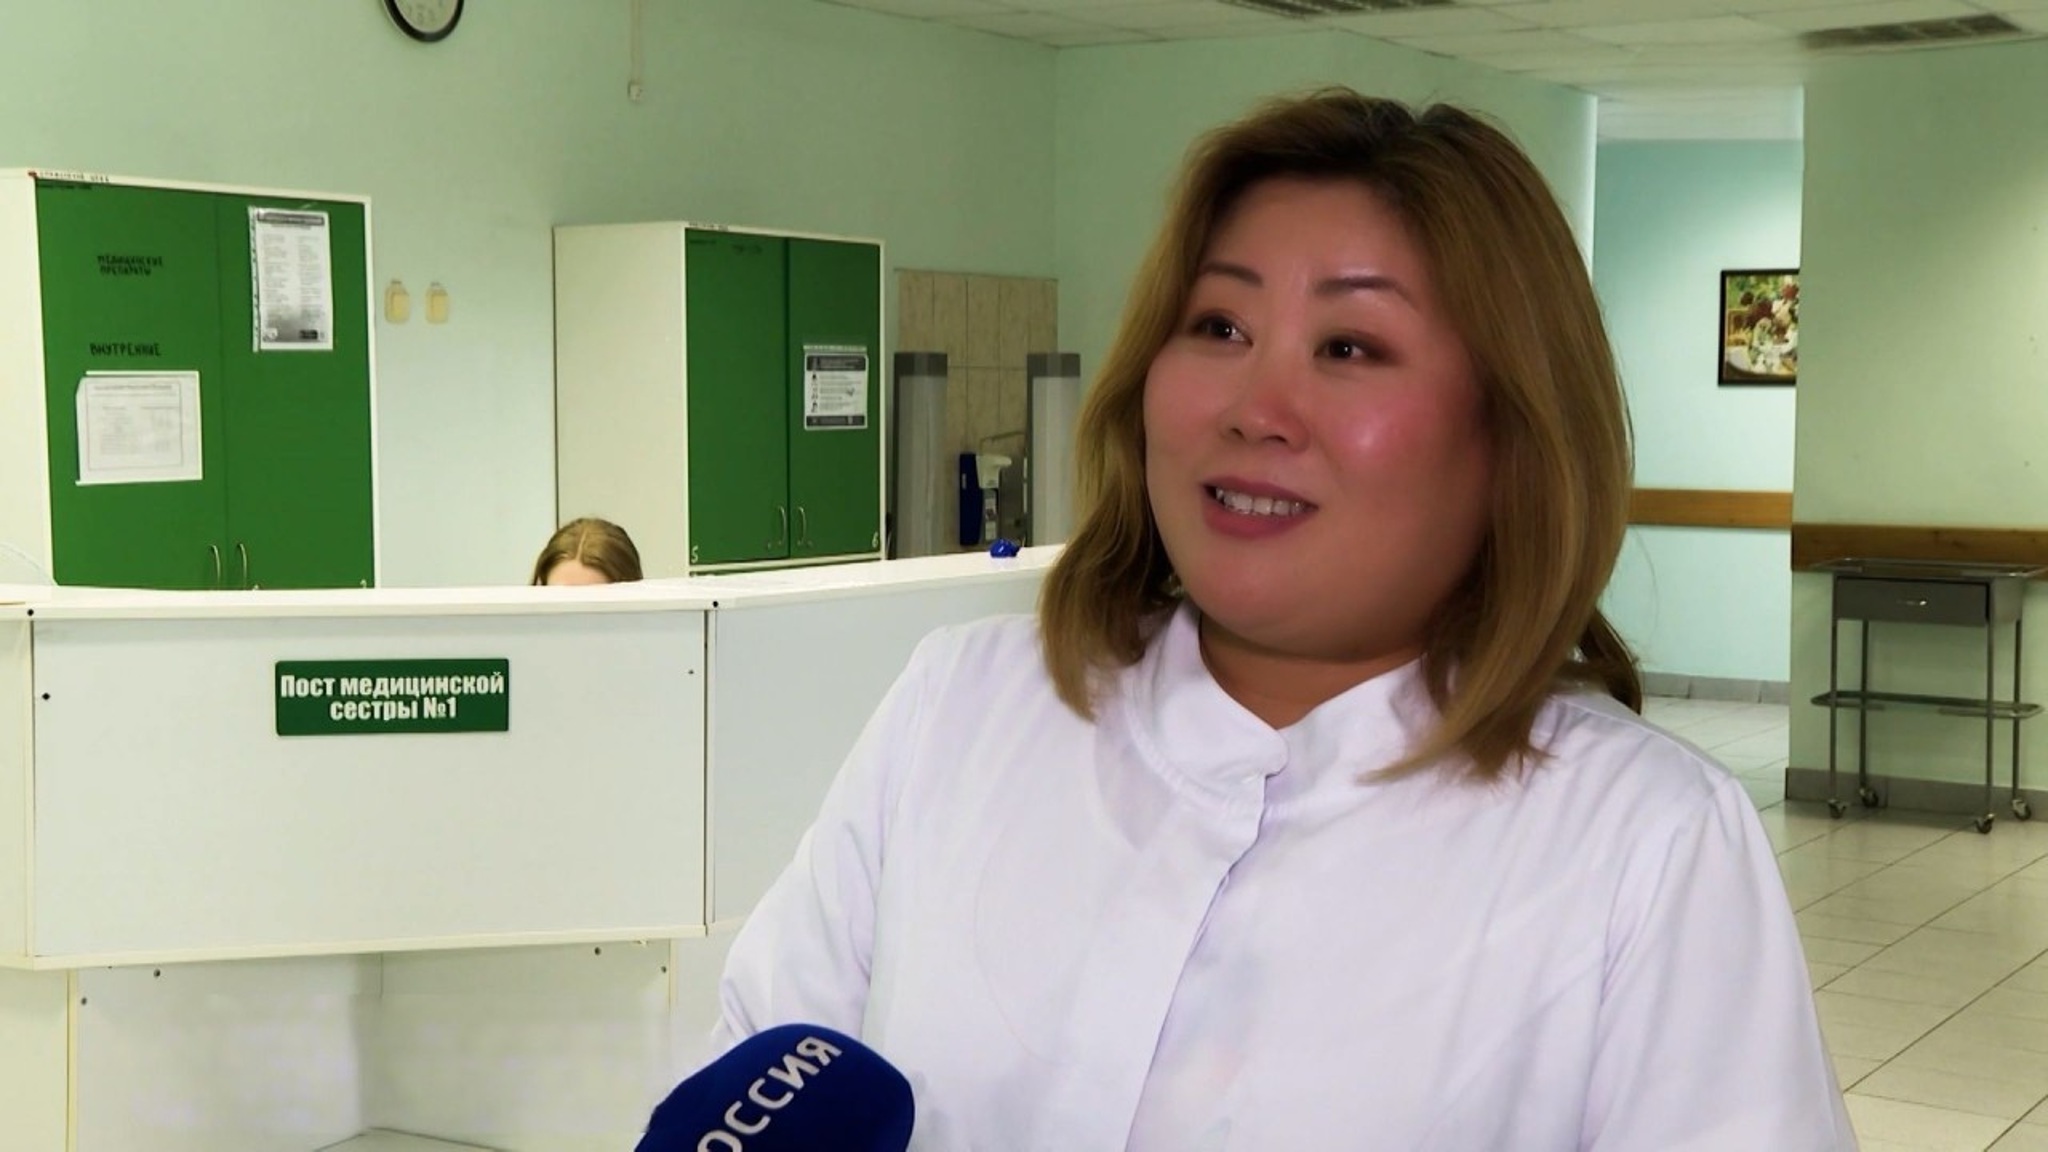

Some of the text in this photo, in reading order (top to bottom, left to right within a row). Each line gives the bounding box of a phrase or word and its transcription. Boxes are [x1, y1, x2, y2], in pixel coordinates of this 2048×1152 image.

[280, 671, 505, 698] Пост медицинской
[330, 697, 457, 721] сестры №1
